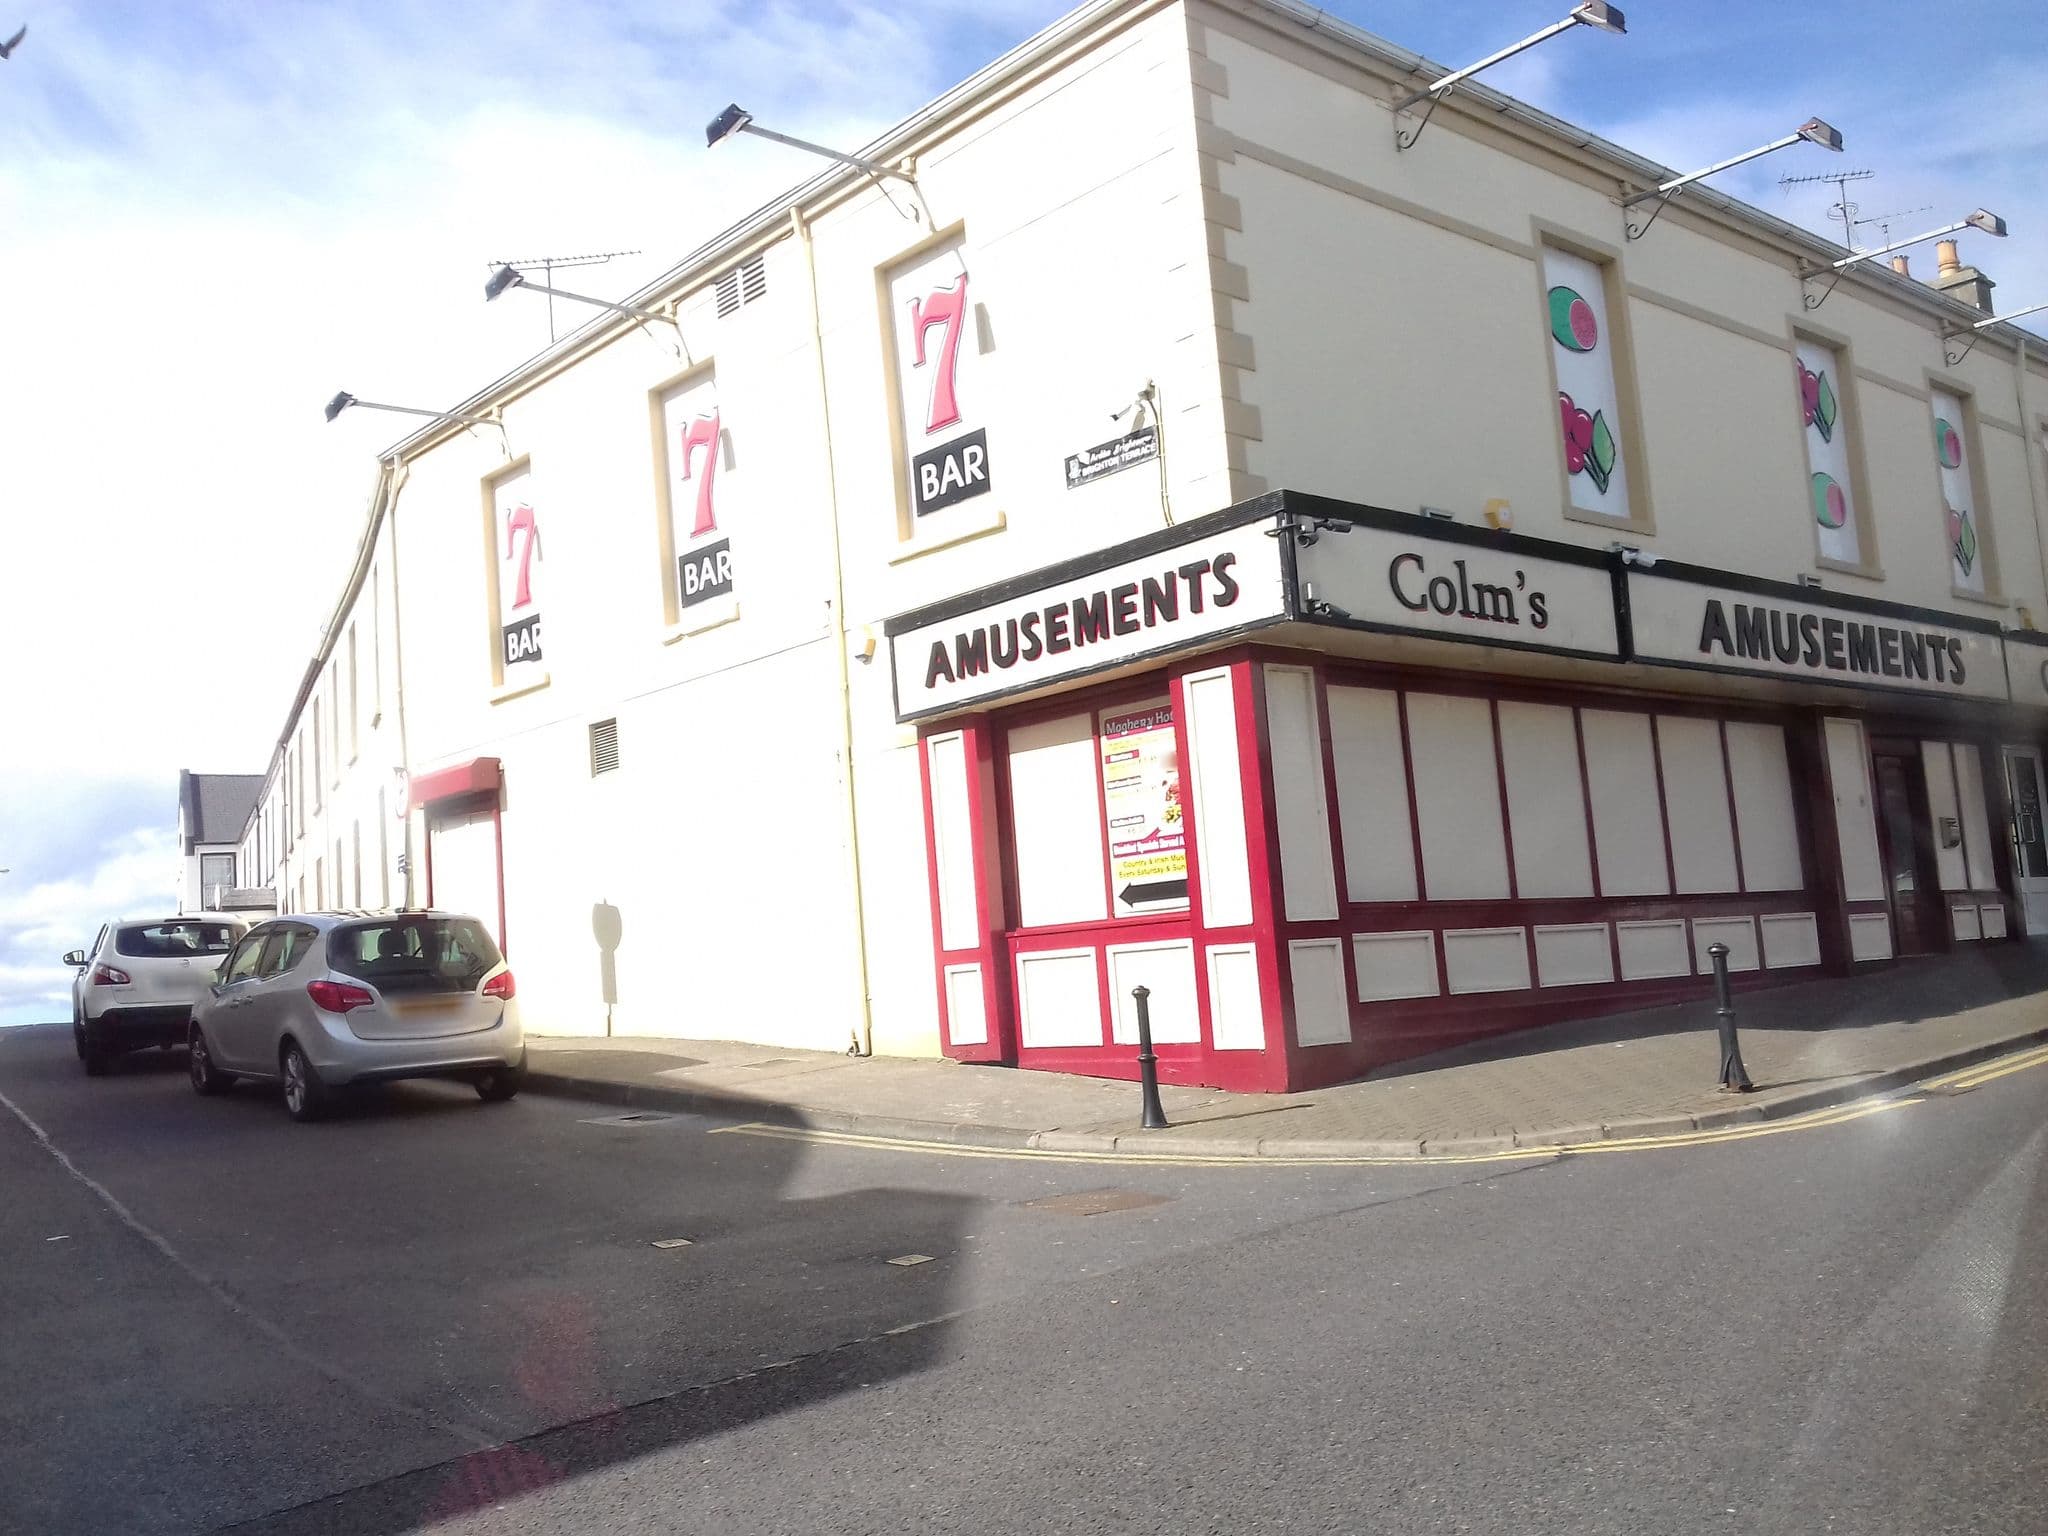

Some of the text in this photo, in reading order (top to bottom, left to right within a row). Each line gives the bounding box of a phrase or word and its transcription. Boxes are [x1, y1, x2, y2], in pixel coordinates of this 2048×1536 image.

[907, 272, 968, 434] 7
[681, 406, 719, 538] 7
[920, 444, 985, 501] BAR
[506, 502, 534, 610] 7
[684, 549, 733, 595] BAR
[1389, 552, 1550, 630] Colm's
[507, 623, 543, 661] BAR
[924, 551, 1240, 689] AMUSEMENTS
[1699, 598, 1967, 685] AMUSEMENTS
